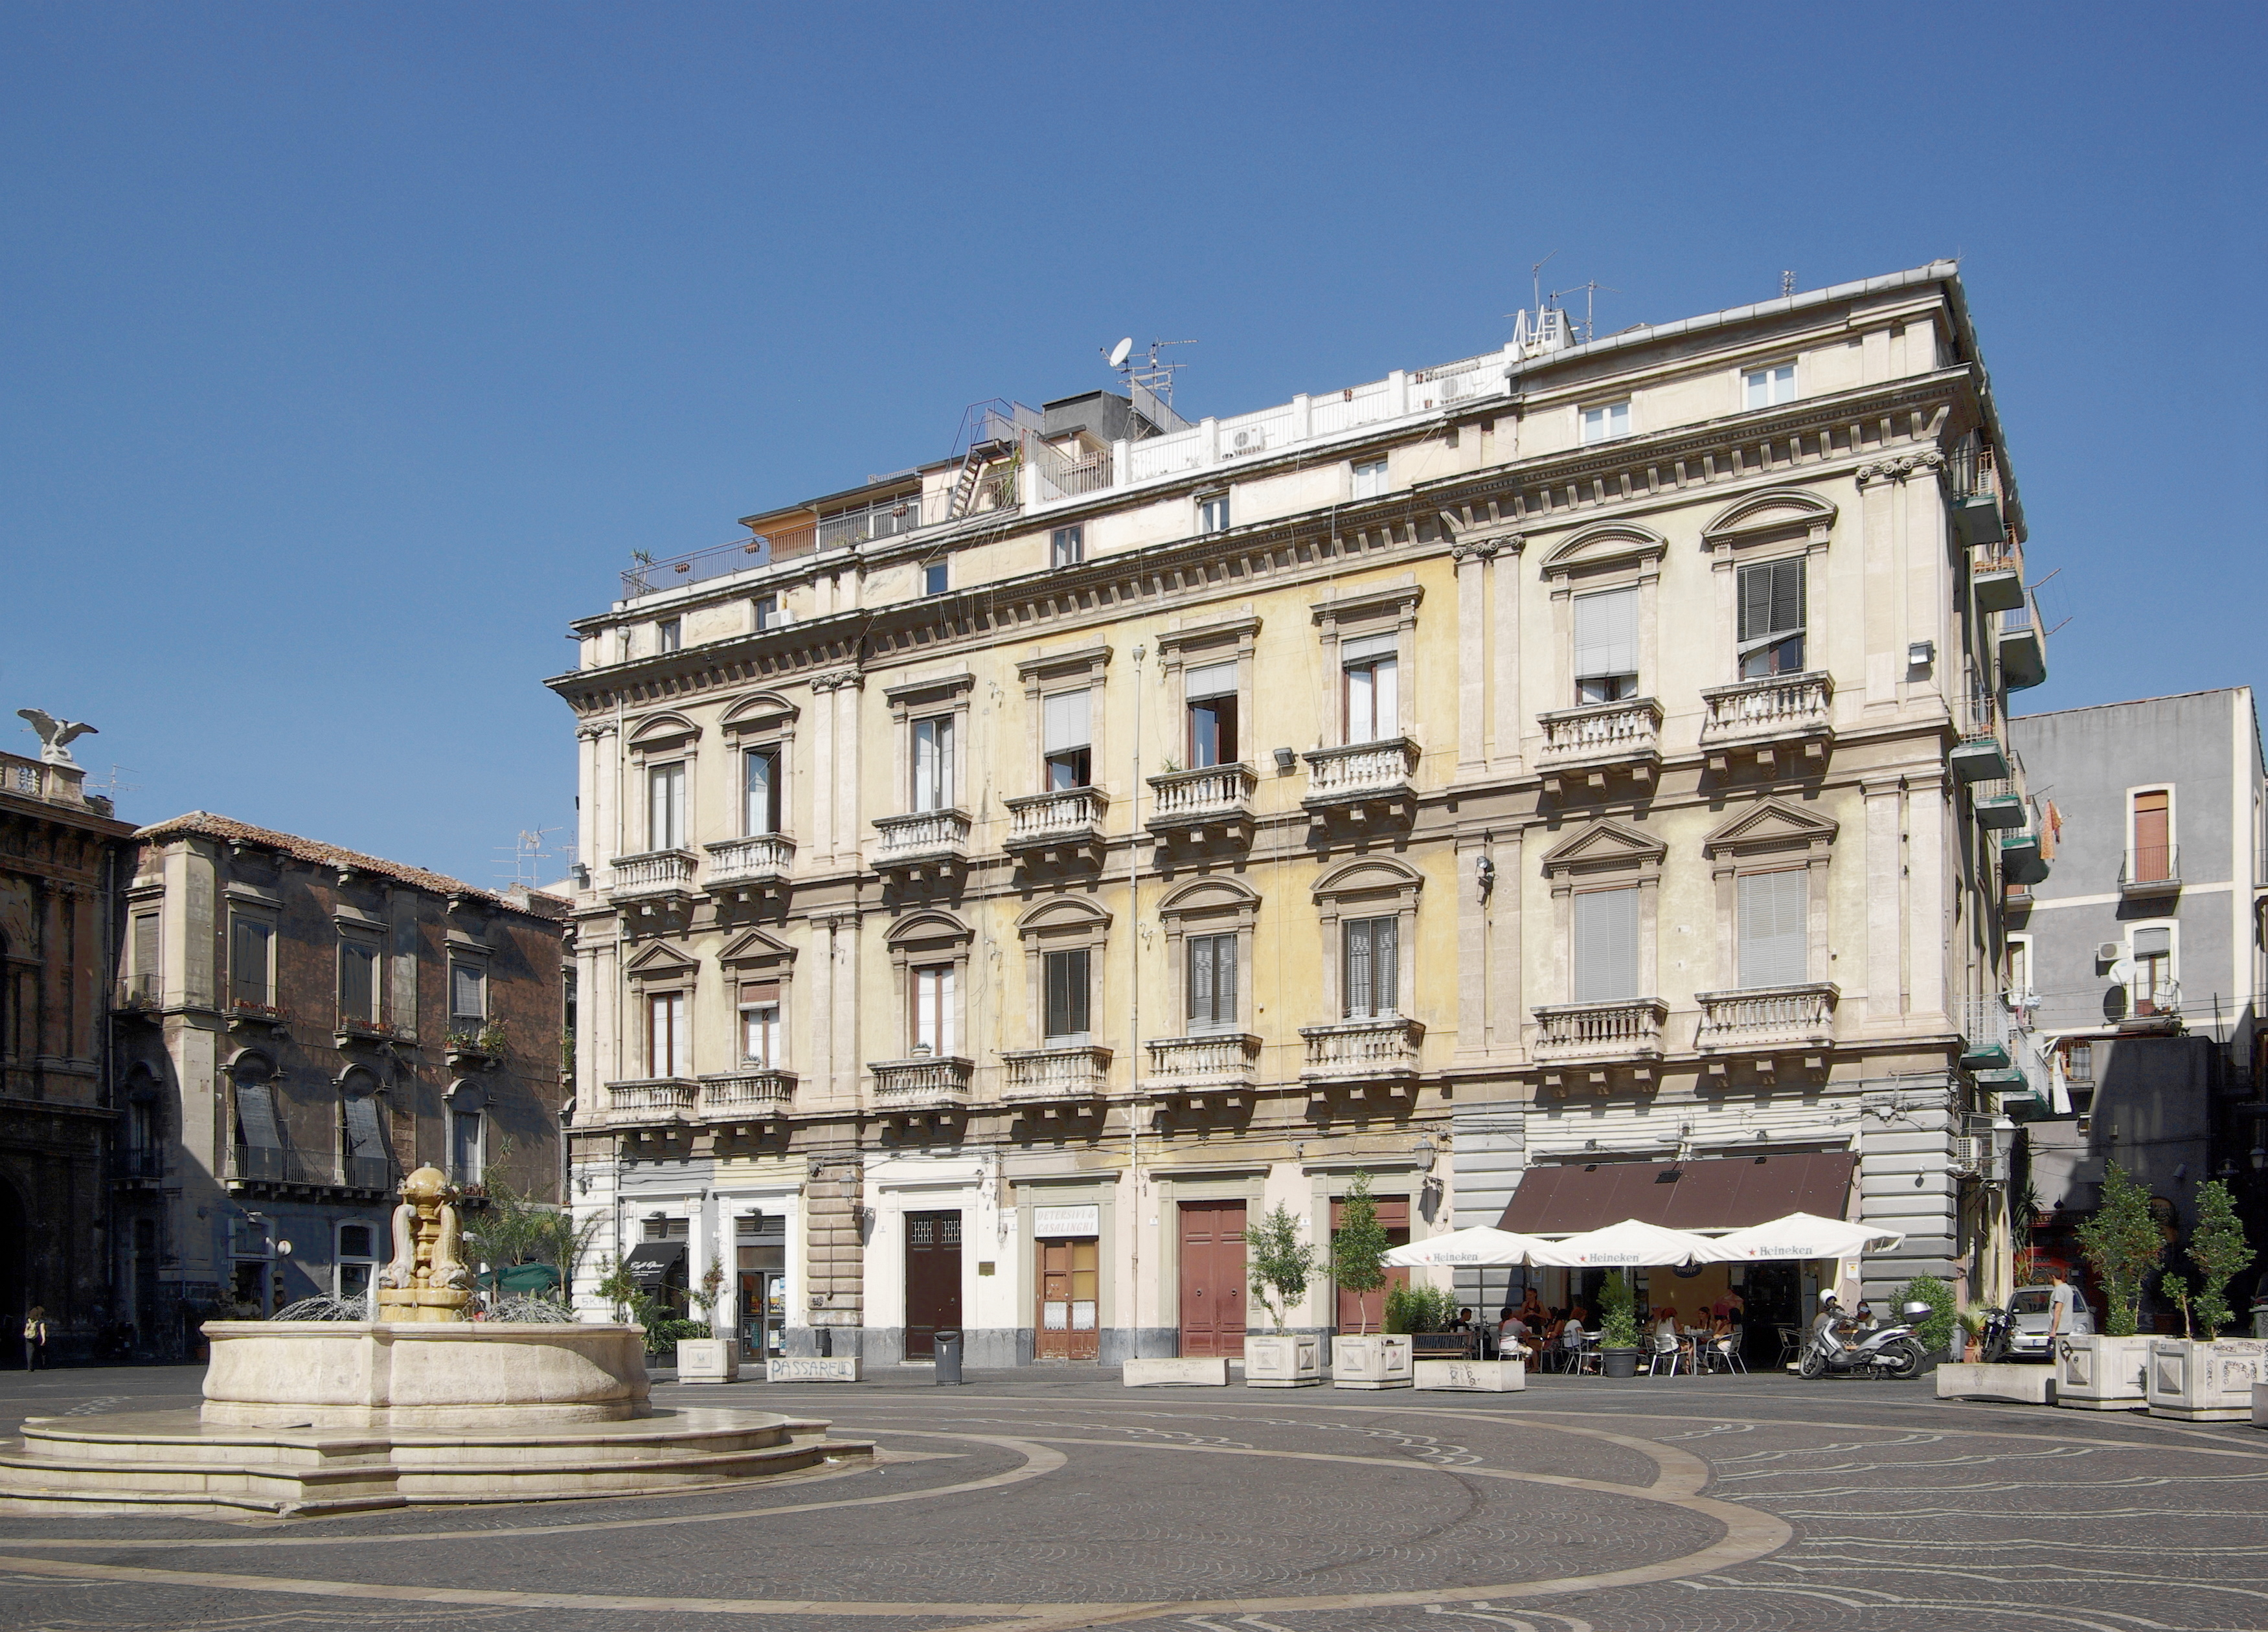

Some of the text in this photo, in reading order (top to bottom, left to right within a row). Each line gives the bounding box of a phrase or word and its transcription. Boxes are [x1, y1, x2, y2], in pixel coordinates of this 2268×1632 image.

[1038, 1208, 1096, 1220] DETERSIVI &
[1038, 1221, 1093, 1233] CASALINGHI
[1760, 1246, 1813, 1256] Heineken
[1433, 1252, 1478, 1262] Heineken
[1589, 1253, 1639, 1262] Heineken
